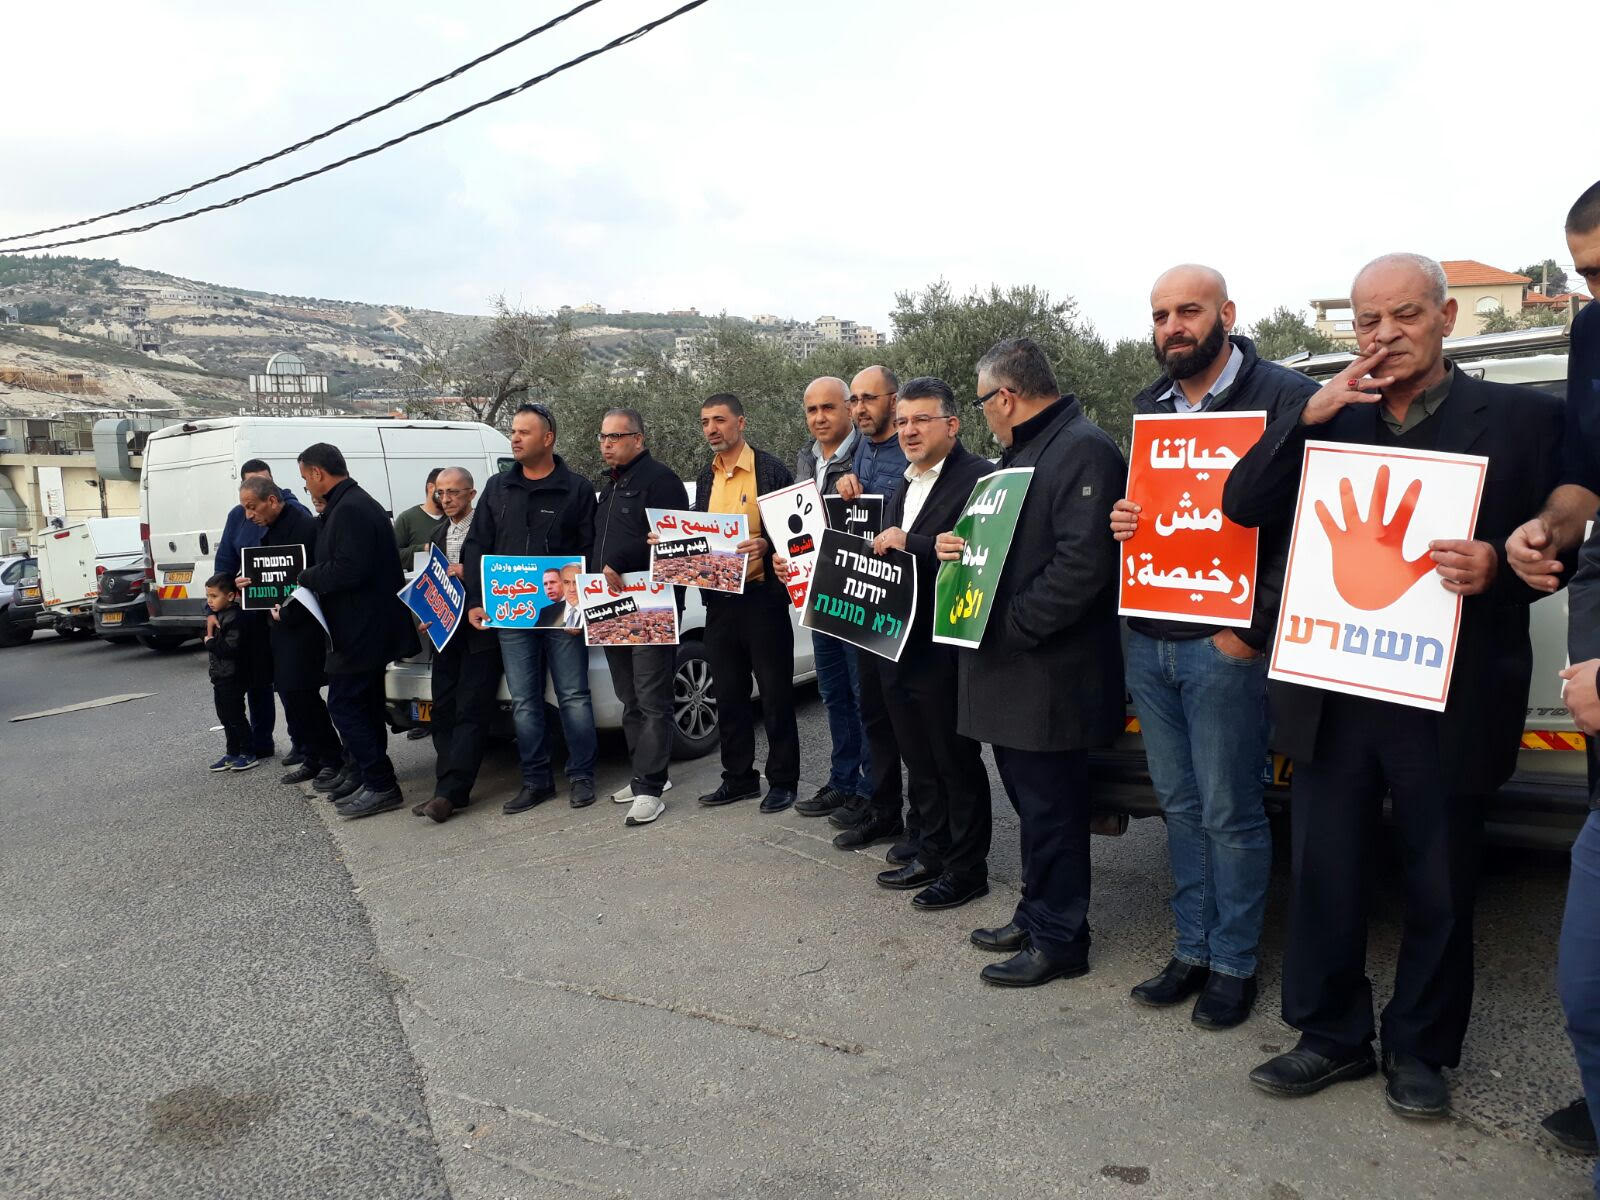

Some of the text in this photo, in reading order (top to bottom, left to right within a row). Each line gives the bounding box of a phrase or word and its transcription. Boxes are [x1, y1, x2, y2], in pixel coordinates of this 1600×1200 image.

[1149, 437, 1241, 481] حياتنا
[656, 515, 739, 539] لن نسمح لكم
[1154, 493, 1223, 537] مش
[253, 555, 294, 568] המשטרה
[835, 548, 902, 585] המשטרה
[261, 571, 287, 583] יודעת
[491, 578, 538, 600] حكومة
[583, 579, 603, 600] لكم
[1125, 552, 1251, 605] رخيصة!
[248, 583, 300, 598] לא מונעת
[843, 577, 886, 605] יודעת
[496, 600, 536, 621] زعران
[814, 592, 903, 639] ולא מונעת
[1284, 614, 1445, 669] משטרע
